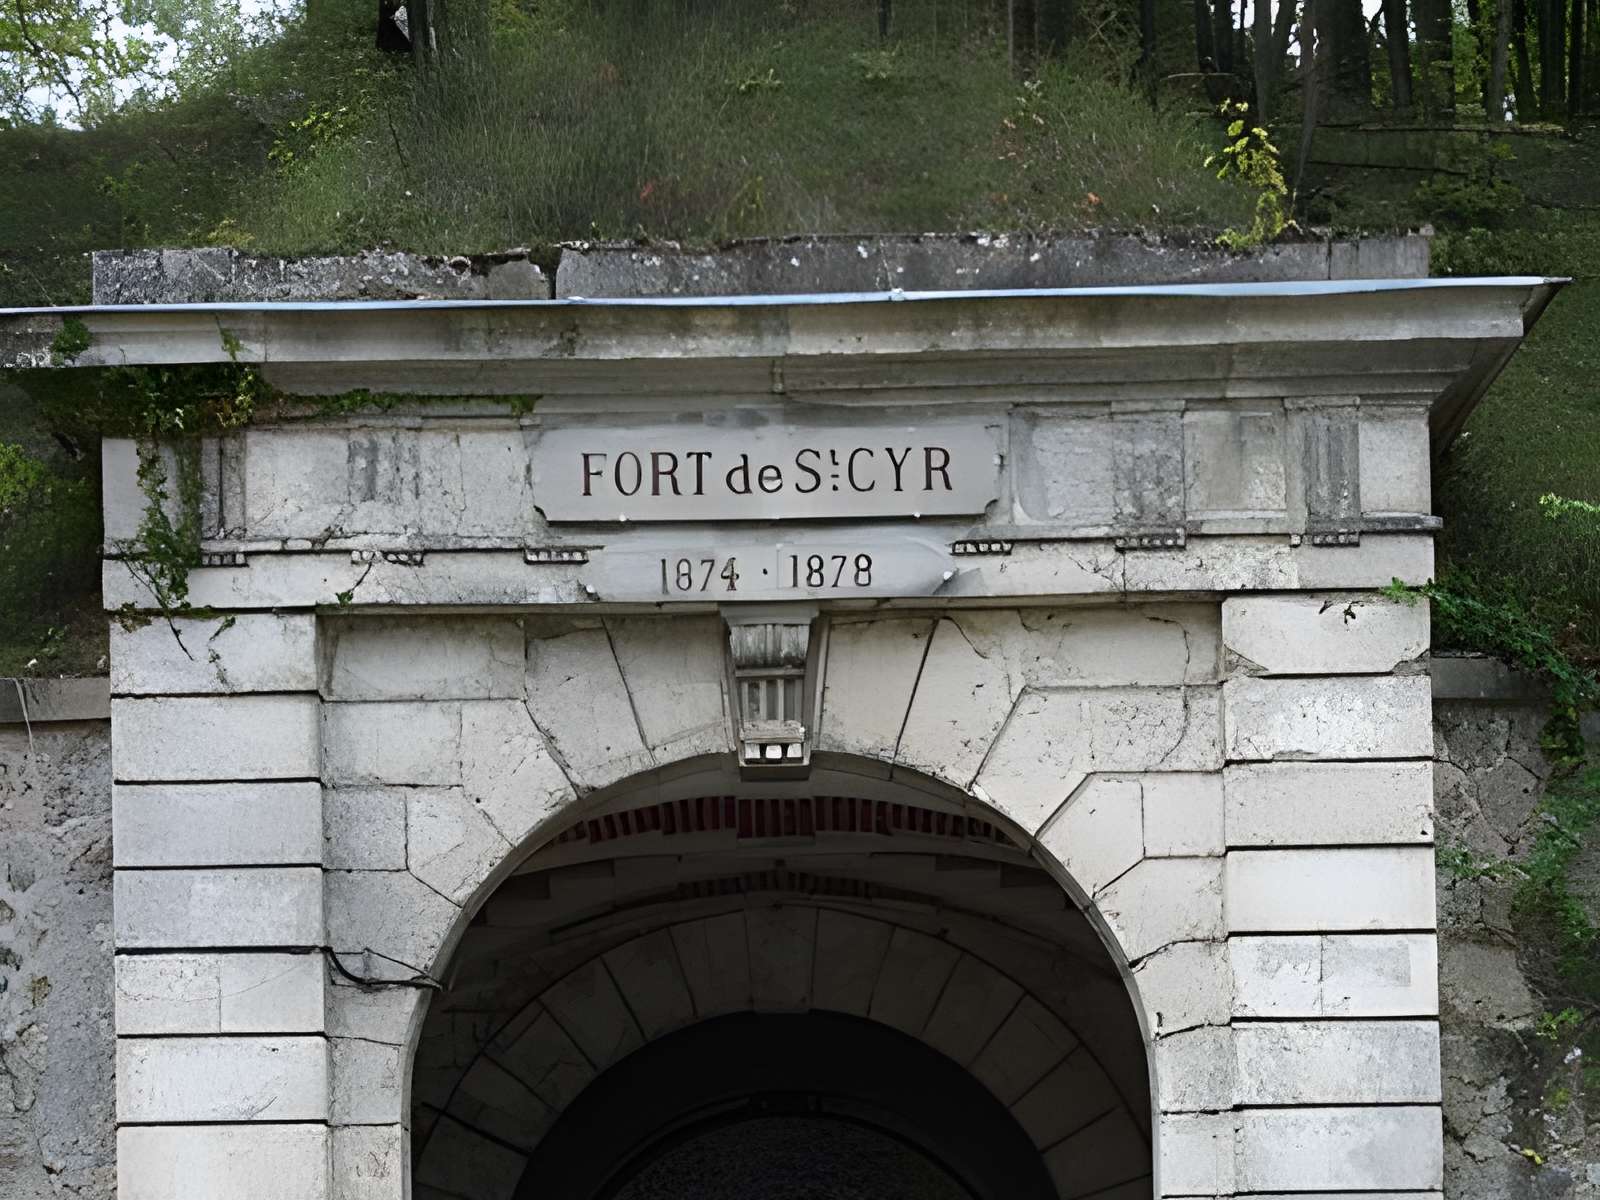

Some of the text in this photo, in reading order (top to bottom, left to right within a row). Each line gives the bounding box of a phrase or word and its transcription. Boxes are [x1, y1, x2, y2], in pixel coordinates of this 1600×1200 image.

[581, 451, 713, 496] FORT
[725, 453, 784, 494] de
[660, 557, 740, 595] 1874
[789, 553, 873, 588] 1878
